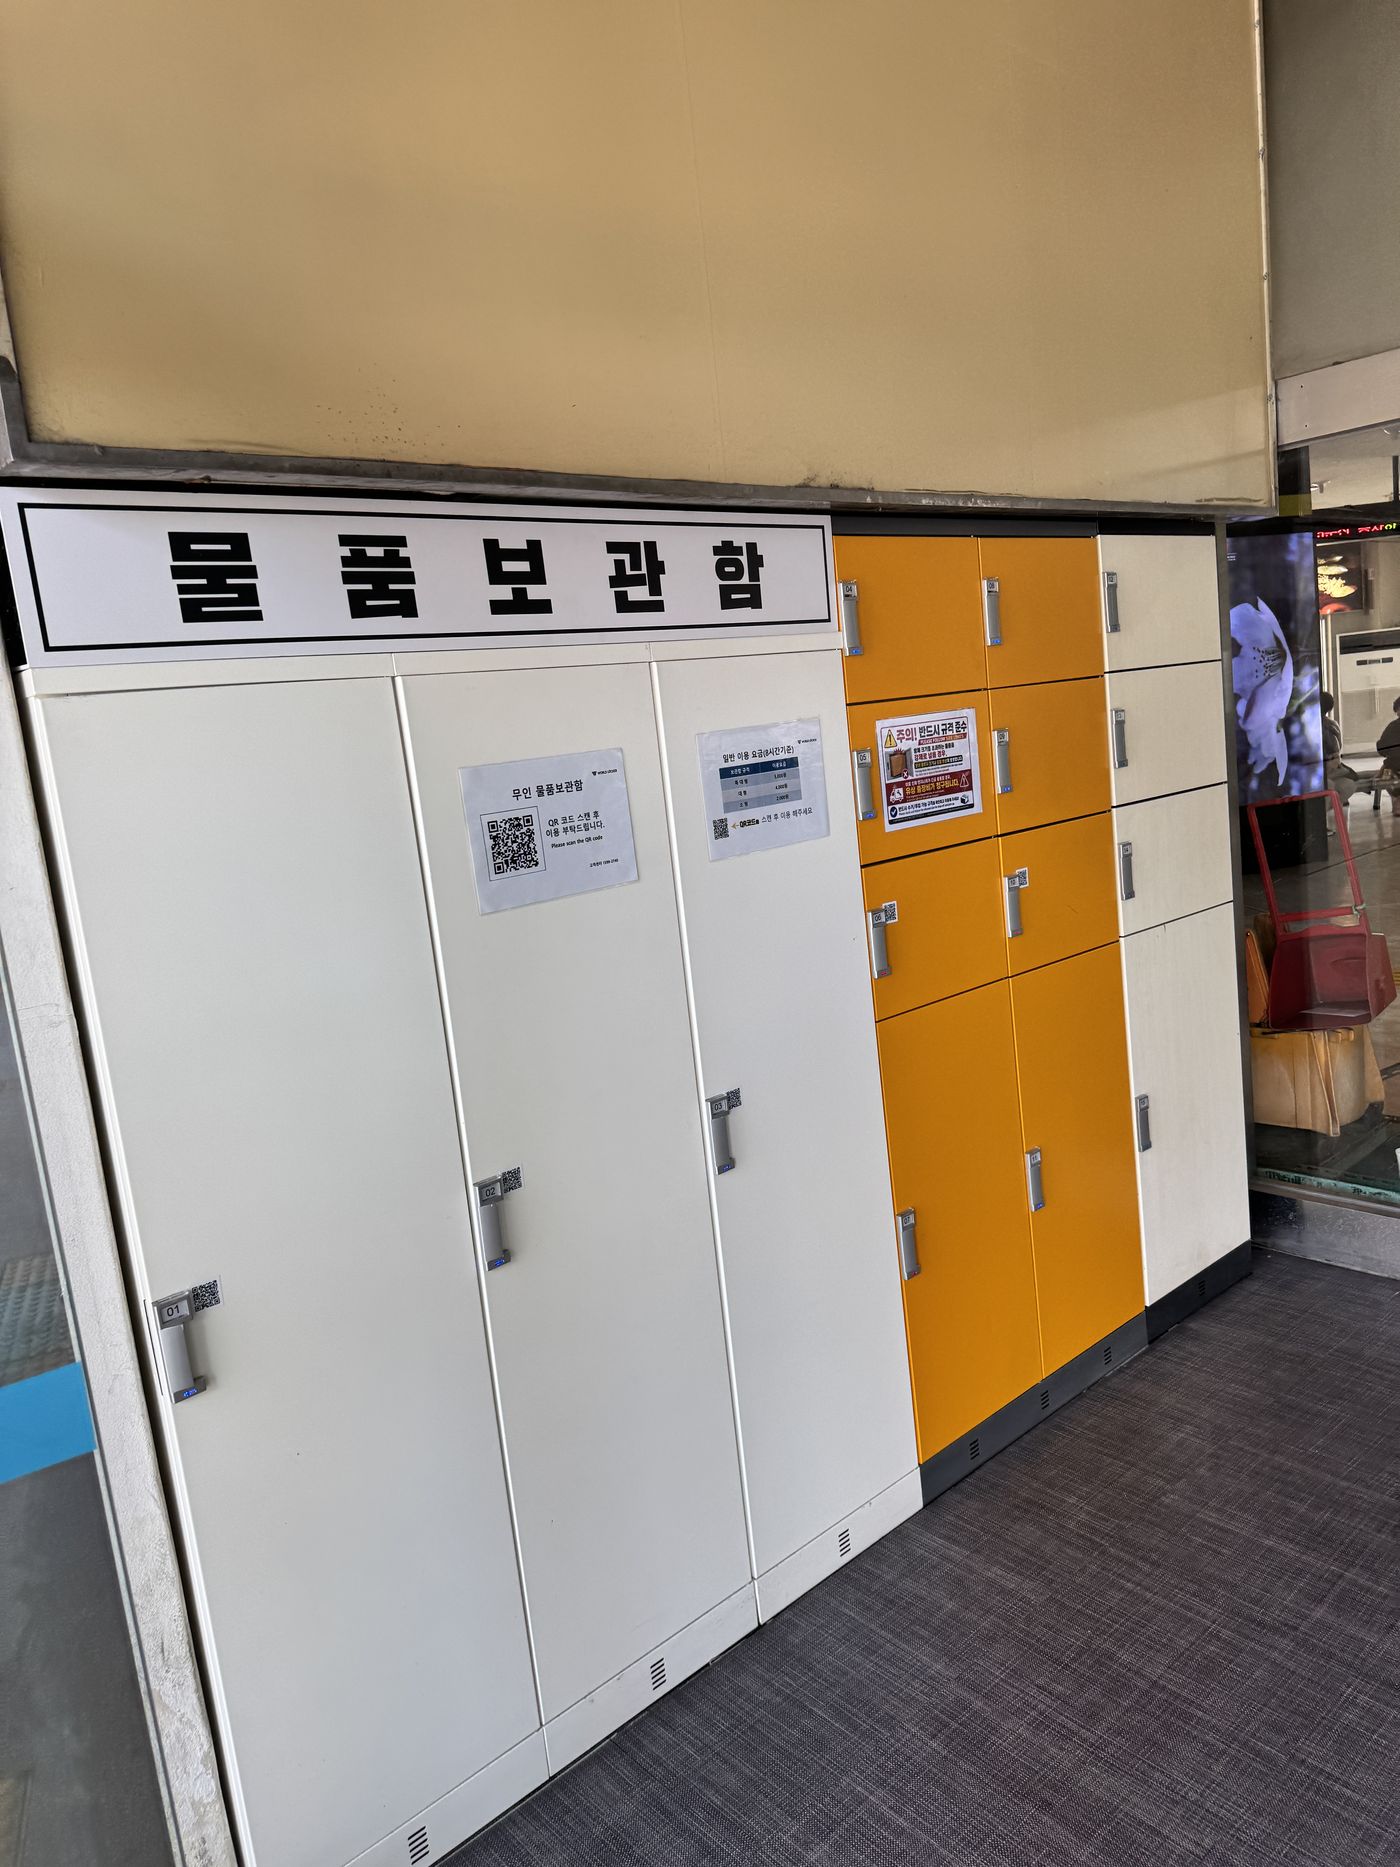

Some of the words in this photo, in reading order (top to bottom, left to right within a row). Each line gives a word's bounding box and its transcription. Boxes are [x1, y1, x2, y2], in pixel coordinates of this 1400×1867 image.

[896, 727, 917, 743] 주의!
[918, 723, 940, 738] 반드시
[940, 721, 954, 735] 규격
[955, 721, 967, 733] 준수
[723, 753, 735, 763] 일반
[737, 751, 749, 761] 이용
[752, 746, 794, 758] 요금(8시간기준)
[859, 753, 867, 761] 05
[512, 787, 532, 801] 무인
[536, 779, 583, 797] 물품보관함
[905, 785, 915, 795] 유상
[548, 819, 559, 827] QR
[561, 815, 575, 824] 코드
[577, 812, 591, 822] 스캔
[593, 811, 600, 819] 후
[546, 828, 560, 837] 이용
[562, 820, 605, 835] 부탁드립니다.
[714, 1102, 722, 1111] 03
[485, 1187, 496, 1197] 02
[166, 1305, 180, 1317] 01
